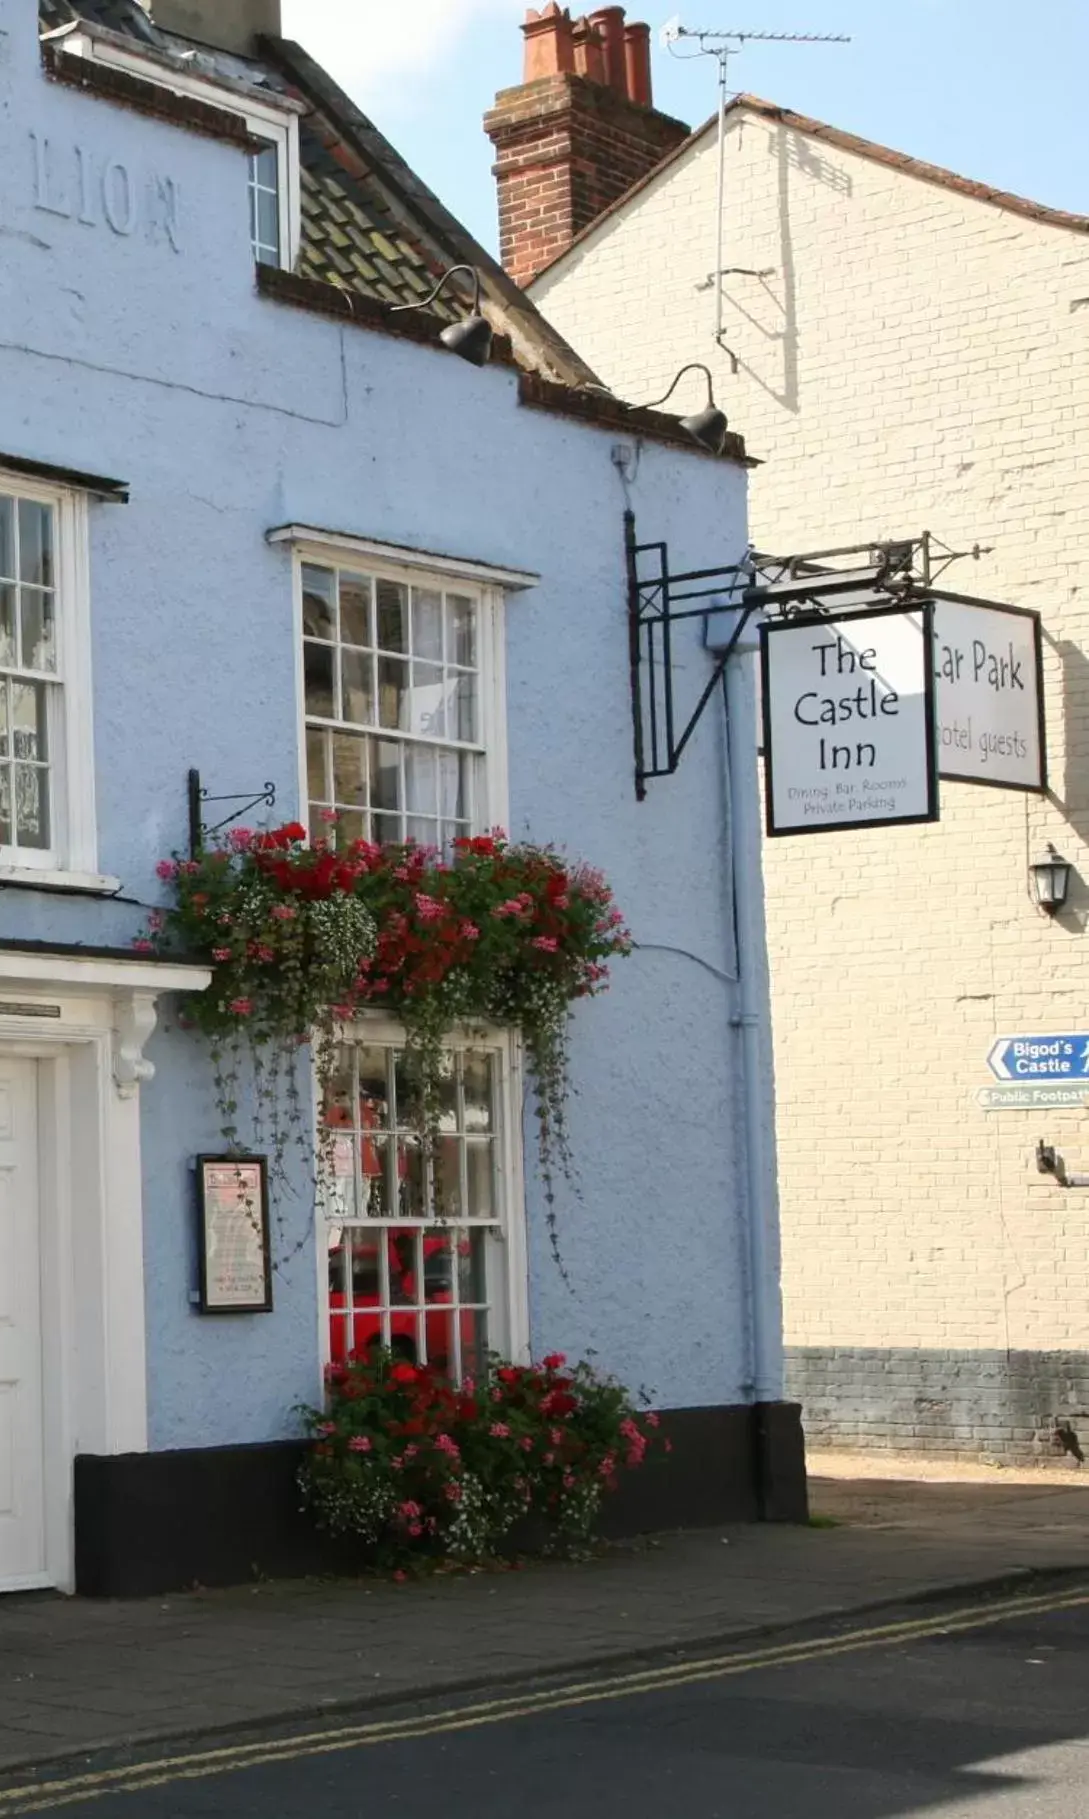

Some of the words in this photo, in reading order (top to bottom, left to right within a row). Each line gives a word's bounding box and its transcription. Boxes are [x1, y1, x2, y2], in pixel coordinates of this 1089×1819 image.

[28, 130, 180, 254] LION
[812, 635, 877, 676] The
[972, 639, 1025, 692] Park
[794, 678, 899, 726] Castle
[819, 737, 877, 770] Inn
[940, 716, 972, 750] otel
[978, 730, 1028, 763] guests
[862, 777, 908, 791] Rooms
[803, 801, 846, 814] Private
[849, 796, 896, 812] Parking
[1013, 1040, 1073, 1059] Bigod's
[1015, 1058, 1071, 1074] Castle
[991, 1090, 1030, 1102] Public
